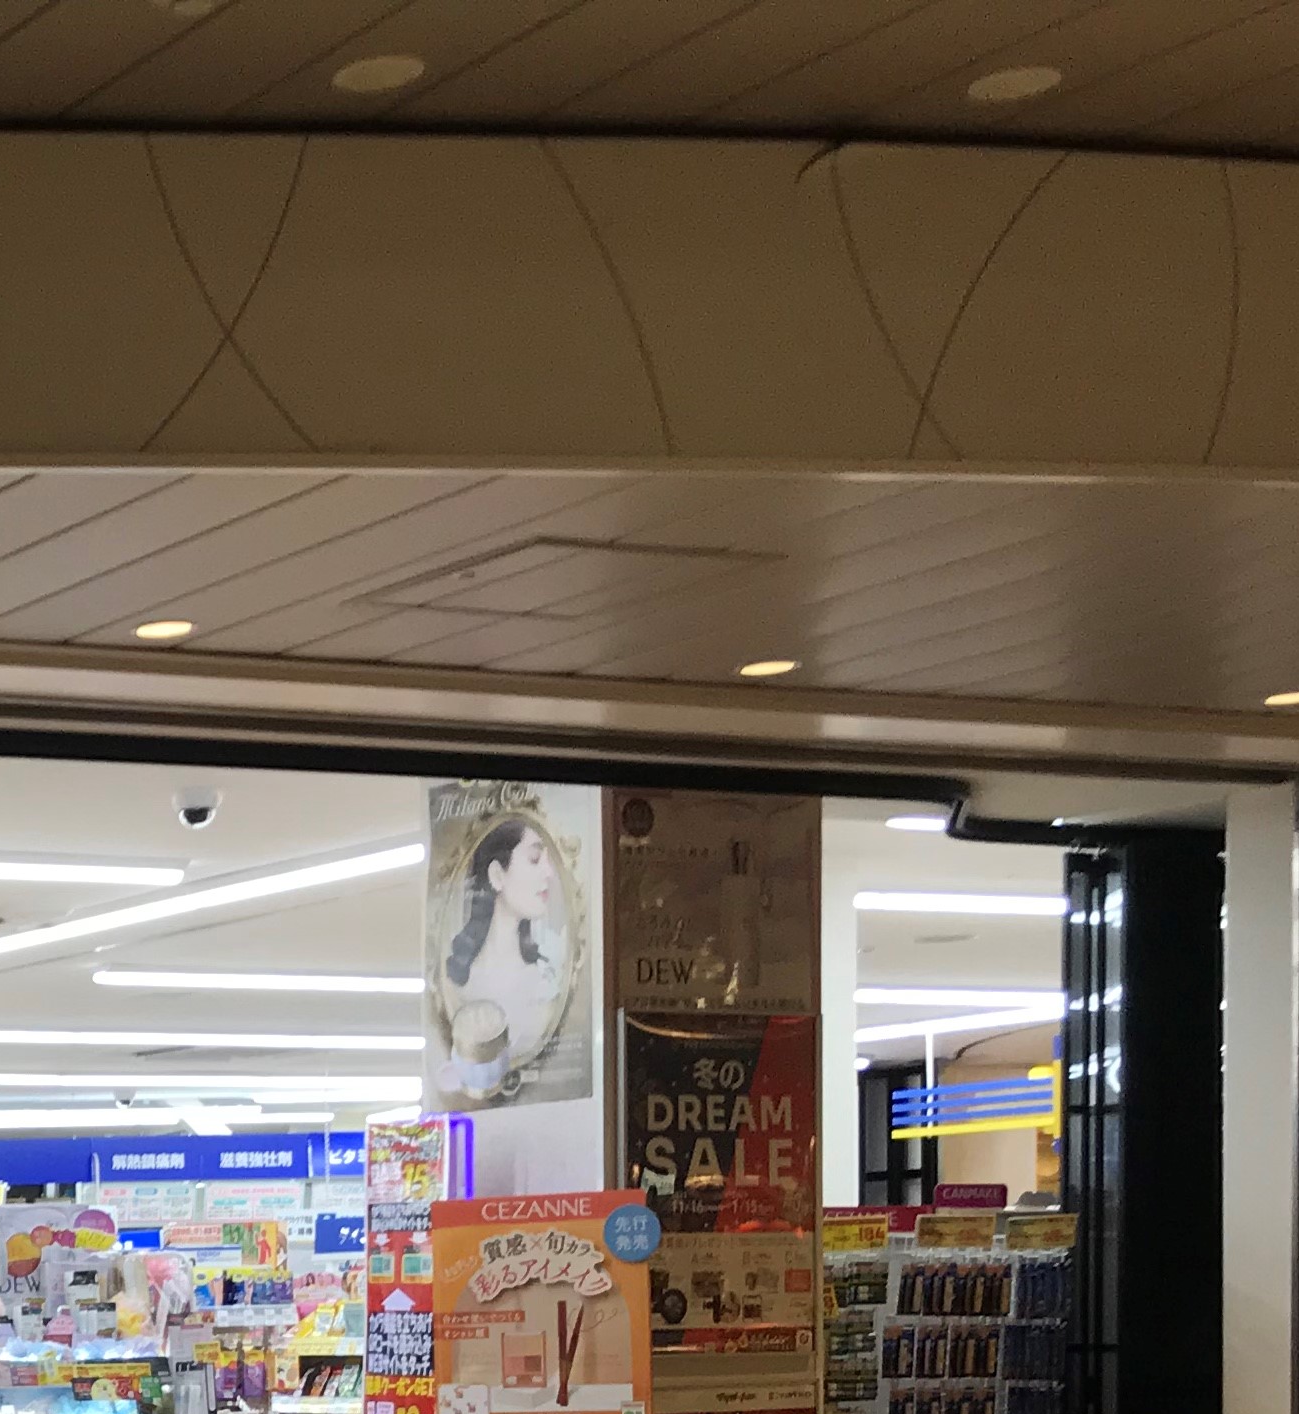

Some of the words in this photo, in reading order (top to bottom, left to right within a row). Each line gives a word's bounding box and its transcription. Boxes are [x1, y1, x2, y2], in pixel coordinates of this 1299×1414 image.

[637, 957, 694, 985] DEW
[693, 1058, 745, 1090] 冬の
[647, 1094, 792, 1131] DREAM
[646, 1136, 793, 1187] SALE
[481, 1197, 592, 1222] CEZANNE
[615, 1215, 648, 1231] 先行
[858, 1227, 885, 1241] 184
[615, 1236, 648, 1250] 発売
